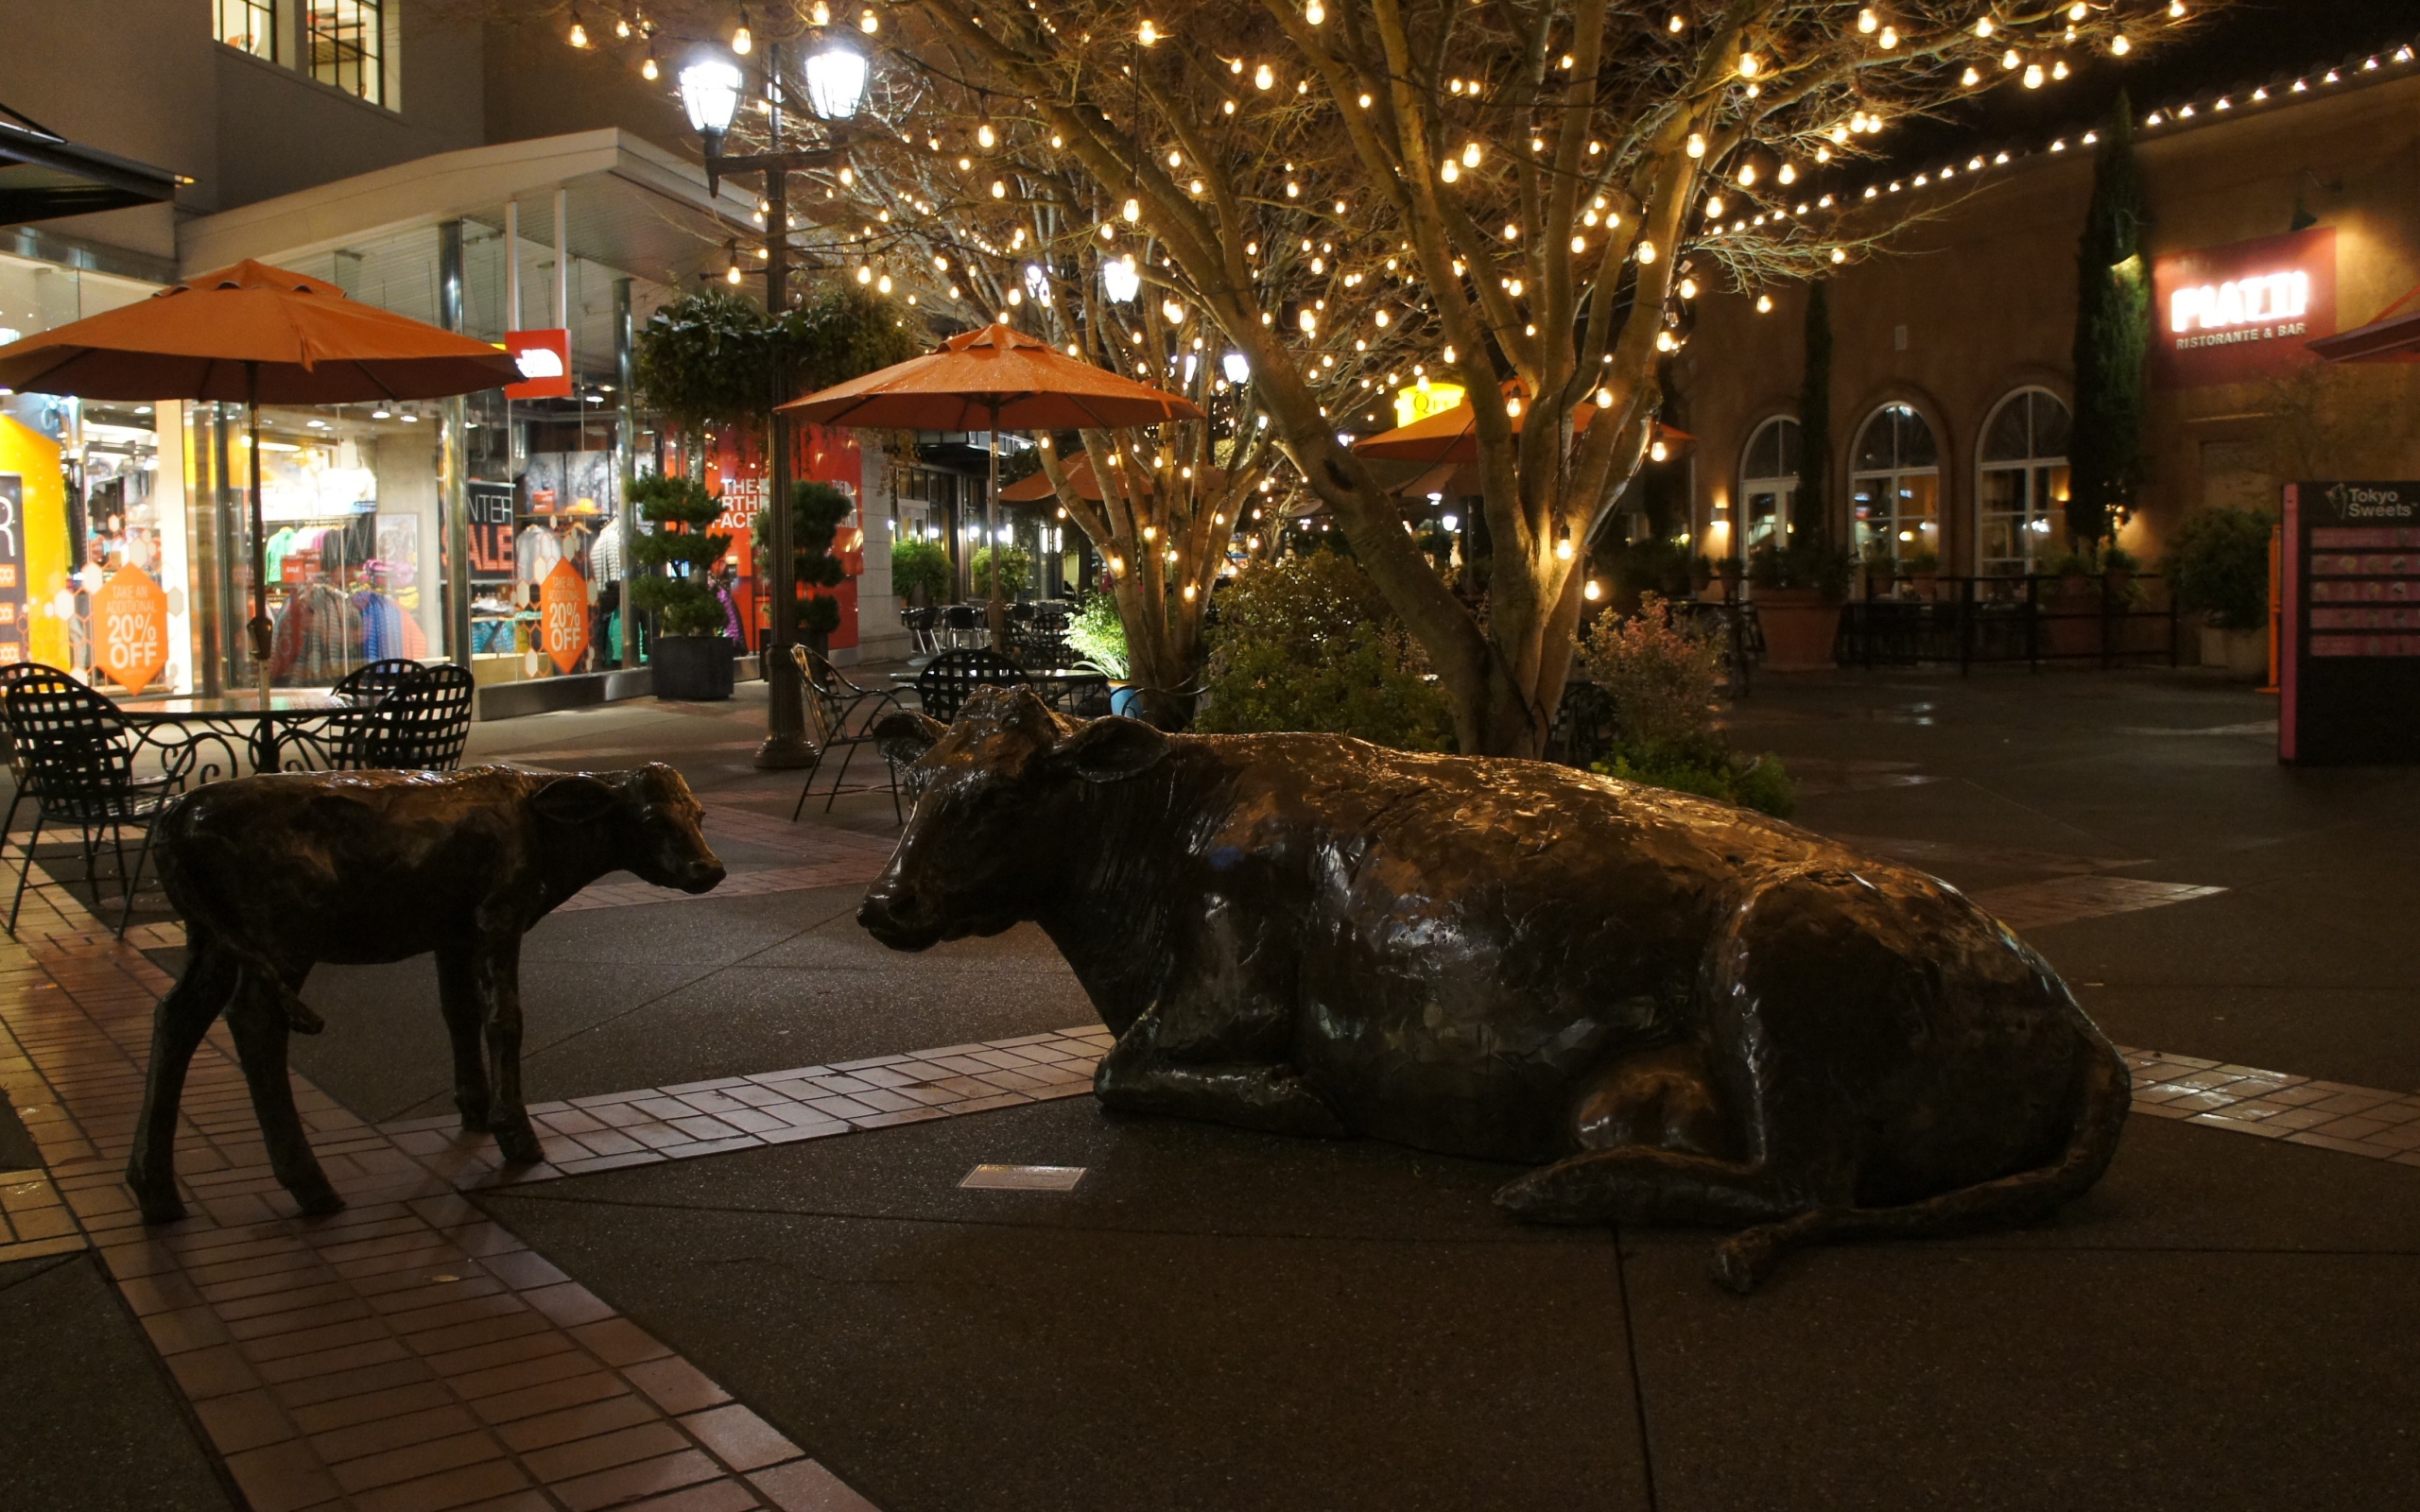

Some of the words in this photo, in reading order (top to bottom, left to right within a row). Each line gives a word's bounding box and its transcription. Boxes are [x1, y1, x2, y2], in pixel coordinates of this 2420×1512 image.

[2176, 328, 2258, 350] RISTORANTE
[2263, 328, 2273, 339] &
[2277, 322, 2306, 337] BAR
[721, 478, 756, 495] THE
[2348, 488, 2399, 504] Tokyo
[467, 492, 512, 524] NTER
[2348, 503, 2412, 517] Sweets
[112, 585, 132, 598] TAKE
[135, 585, 148, 598] AN
[552, 576, 566, 588] TAKE
[106, 599, 157, 614] ADDITIONAL
[549, 602, 580, 629] 20%
[107, 613, 157, 644] 20%
[550, 627, 580, 651] OFF
[110, 642, 158, 669] OFF
